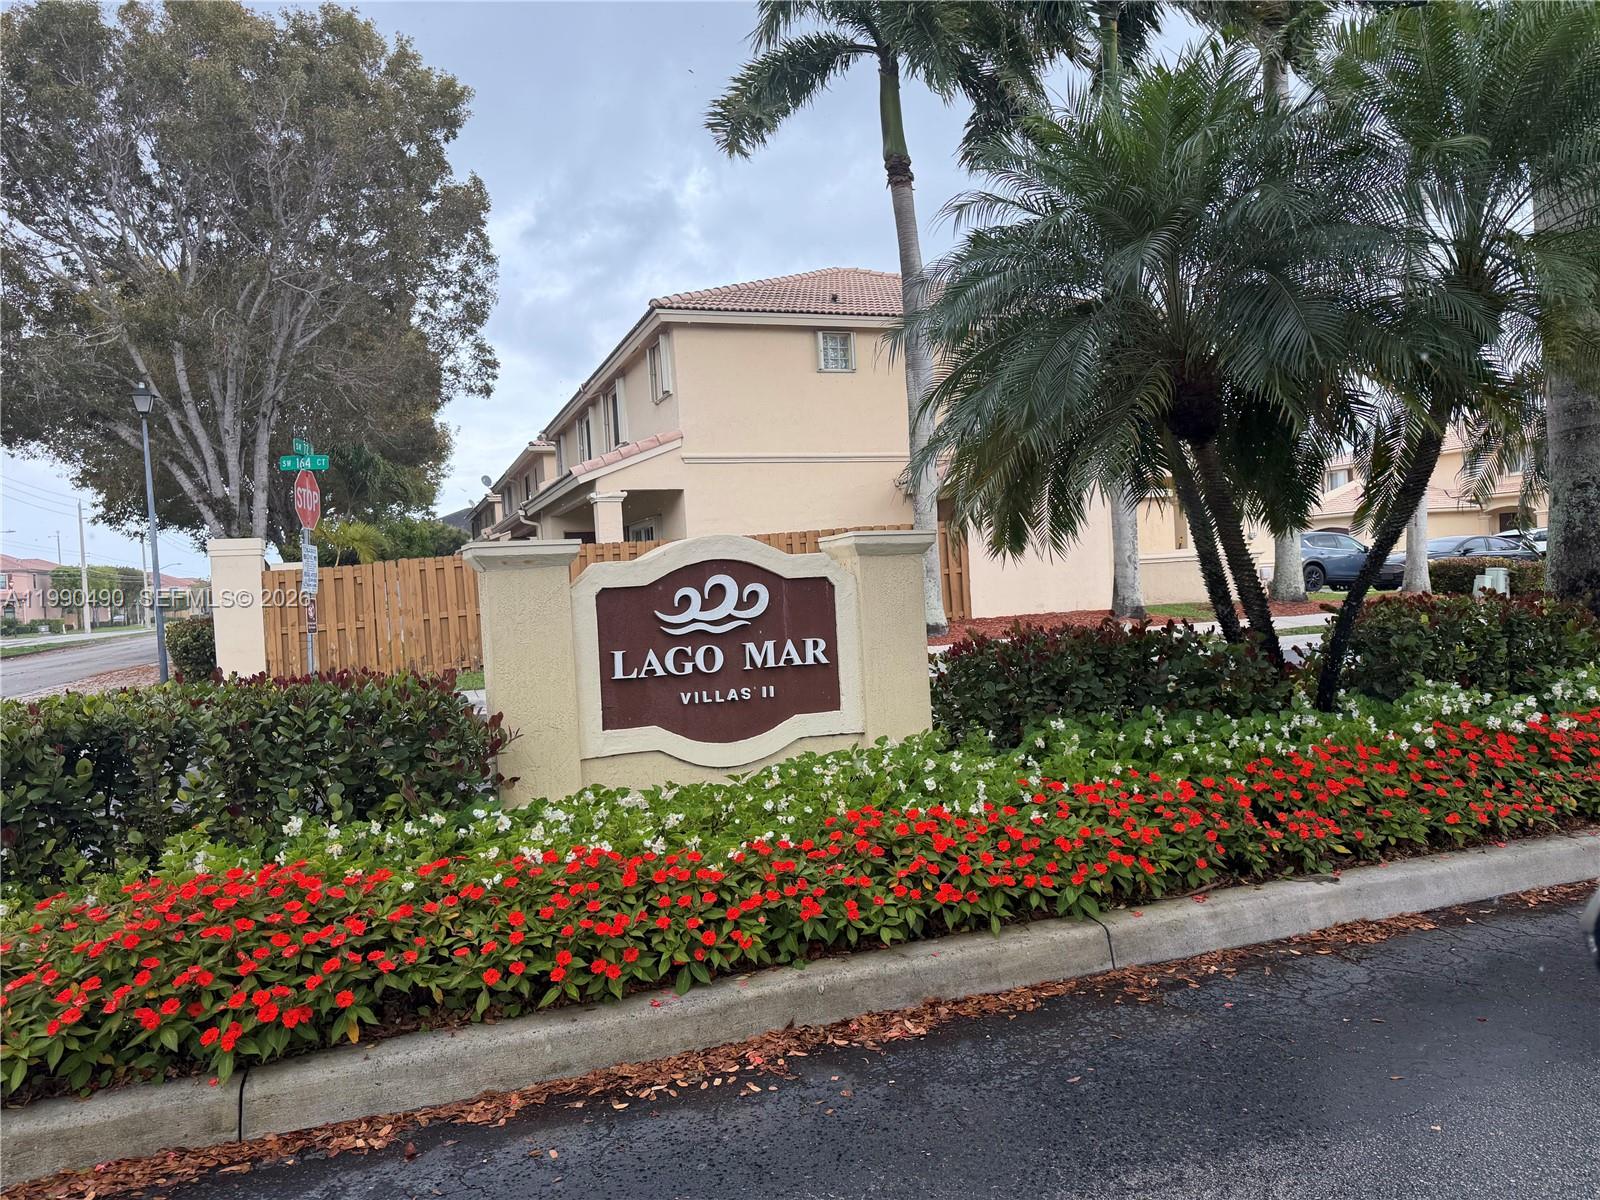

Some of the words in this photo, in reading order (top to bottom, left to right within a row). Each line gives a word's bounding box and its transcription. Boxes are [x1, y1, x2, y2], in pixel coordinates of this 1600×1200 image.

[282, 459, 291, 467] SW
[296, 458, 311, 469] 164
[316, 458, 326, 466] CT
[297, 486, 318, 512] STOP
[611, 645, 725, 680] LAGO
[741, 637, 830, 670] MAR
[680, 686, 751, 705] VILLAS
[762, 685, 775, 698] II
